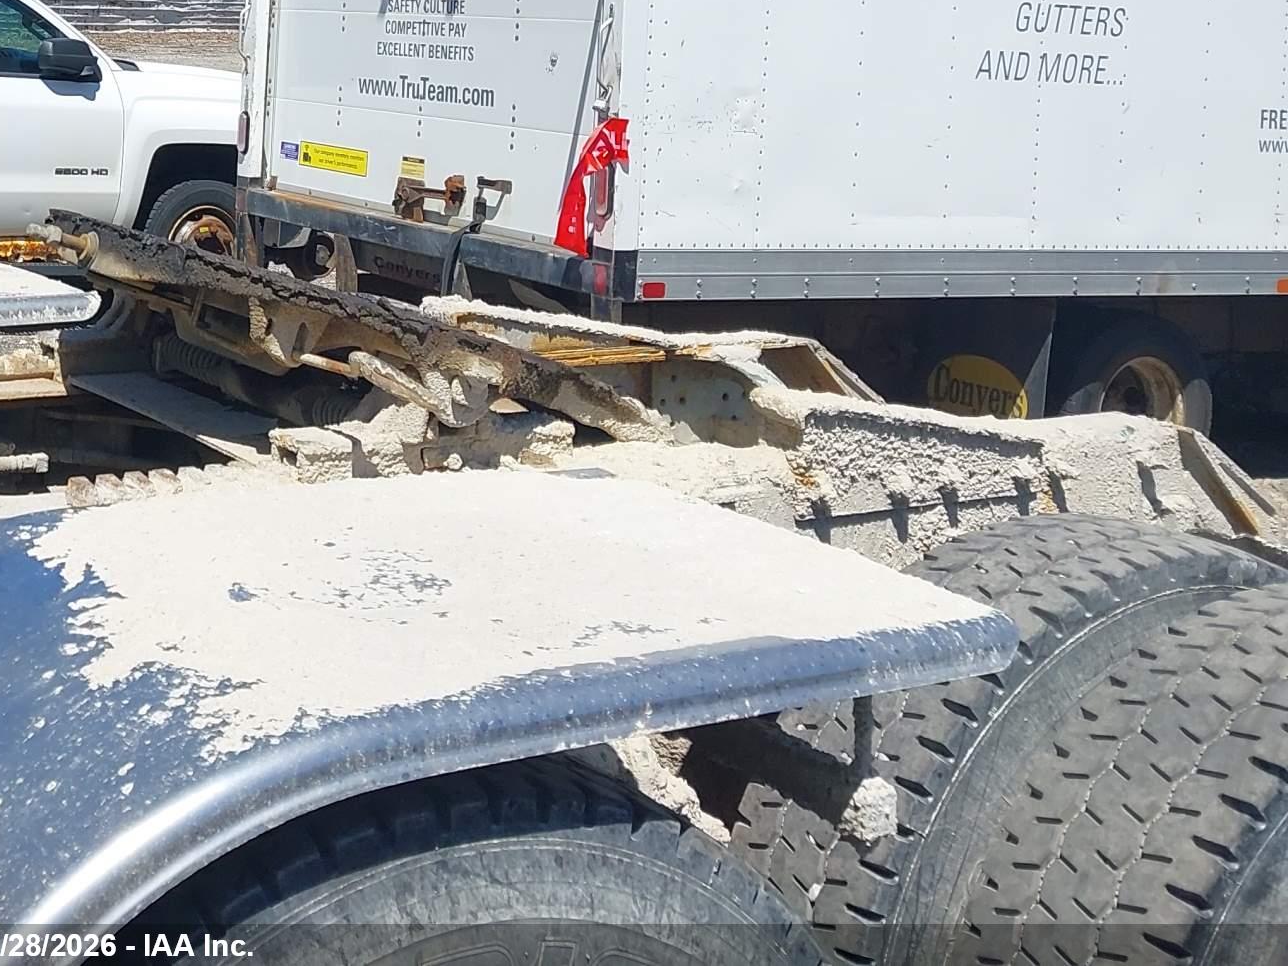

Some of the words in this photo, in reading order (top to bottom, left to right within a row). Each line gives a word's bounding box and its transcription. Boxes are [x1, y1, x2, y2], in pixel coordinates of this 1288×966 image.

[423, 0, 466, 15] CULTURE
[385, 19, 446, 37] COMPETITIVE
[448, 22, 467, 38] PAY
[1016, 1, 1127, 37] GUTTERS
[377, 41, 427, 59] EXCELLENT
[428, 43, 474, 62] BENEFITS
[975, 50, 1031, 81] AND
[1038, 53, 1123, 85] MORE...
[358, 74, 495, 108] www.TruTeam.com
[90, 167, 109, 176] HD
